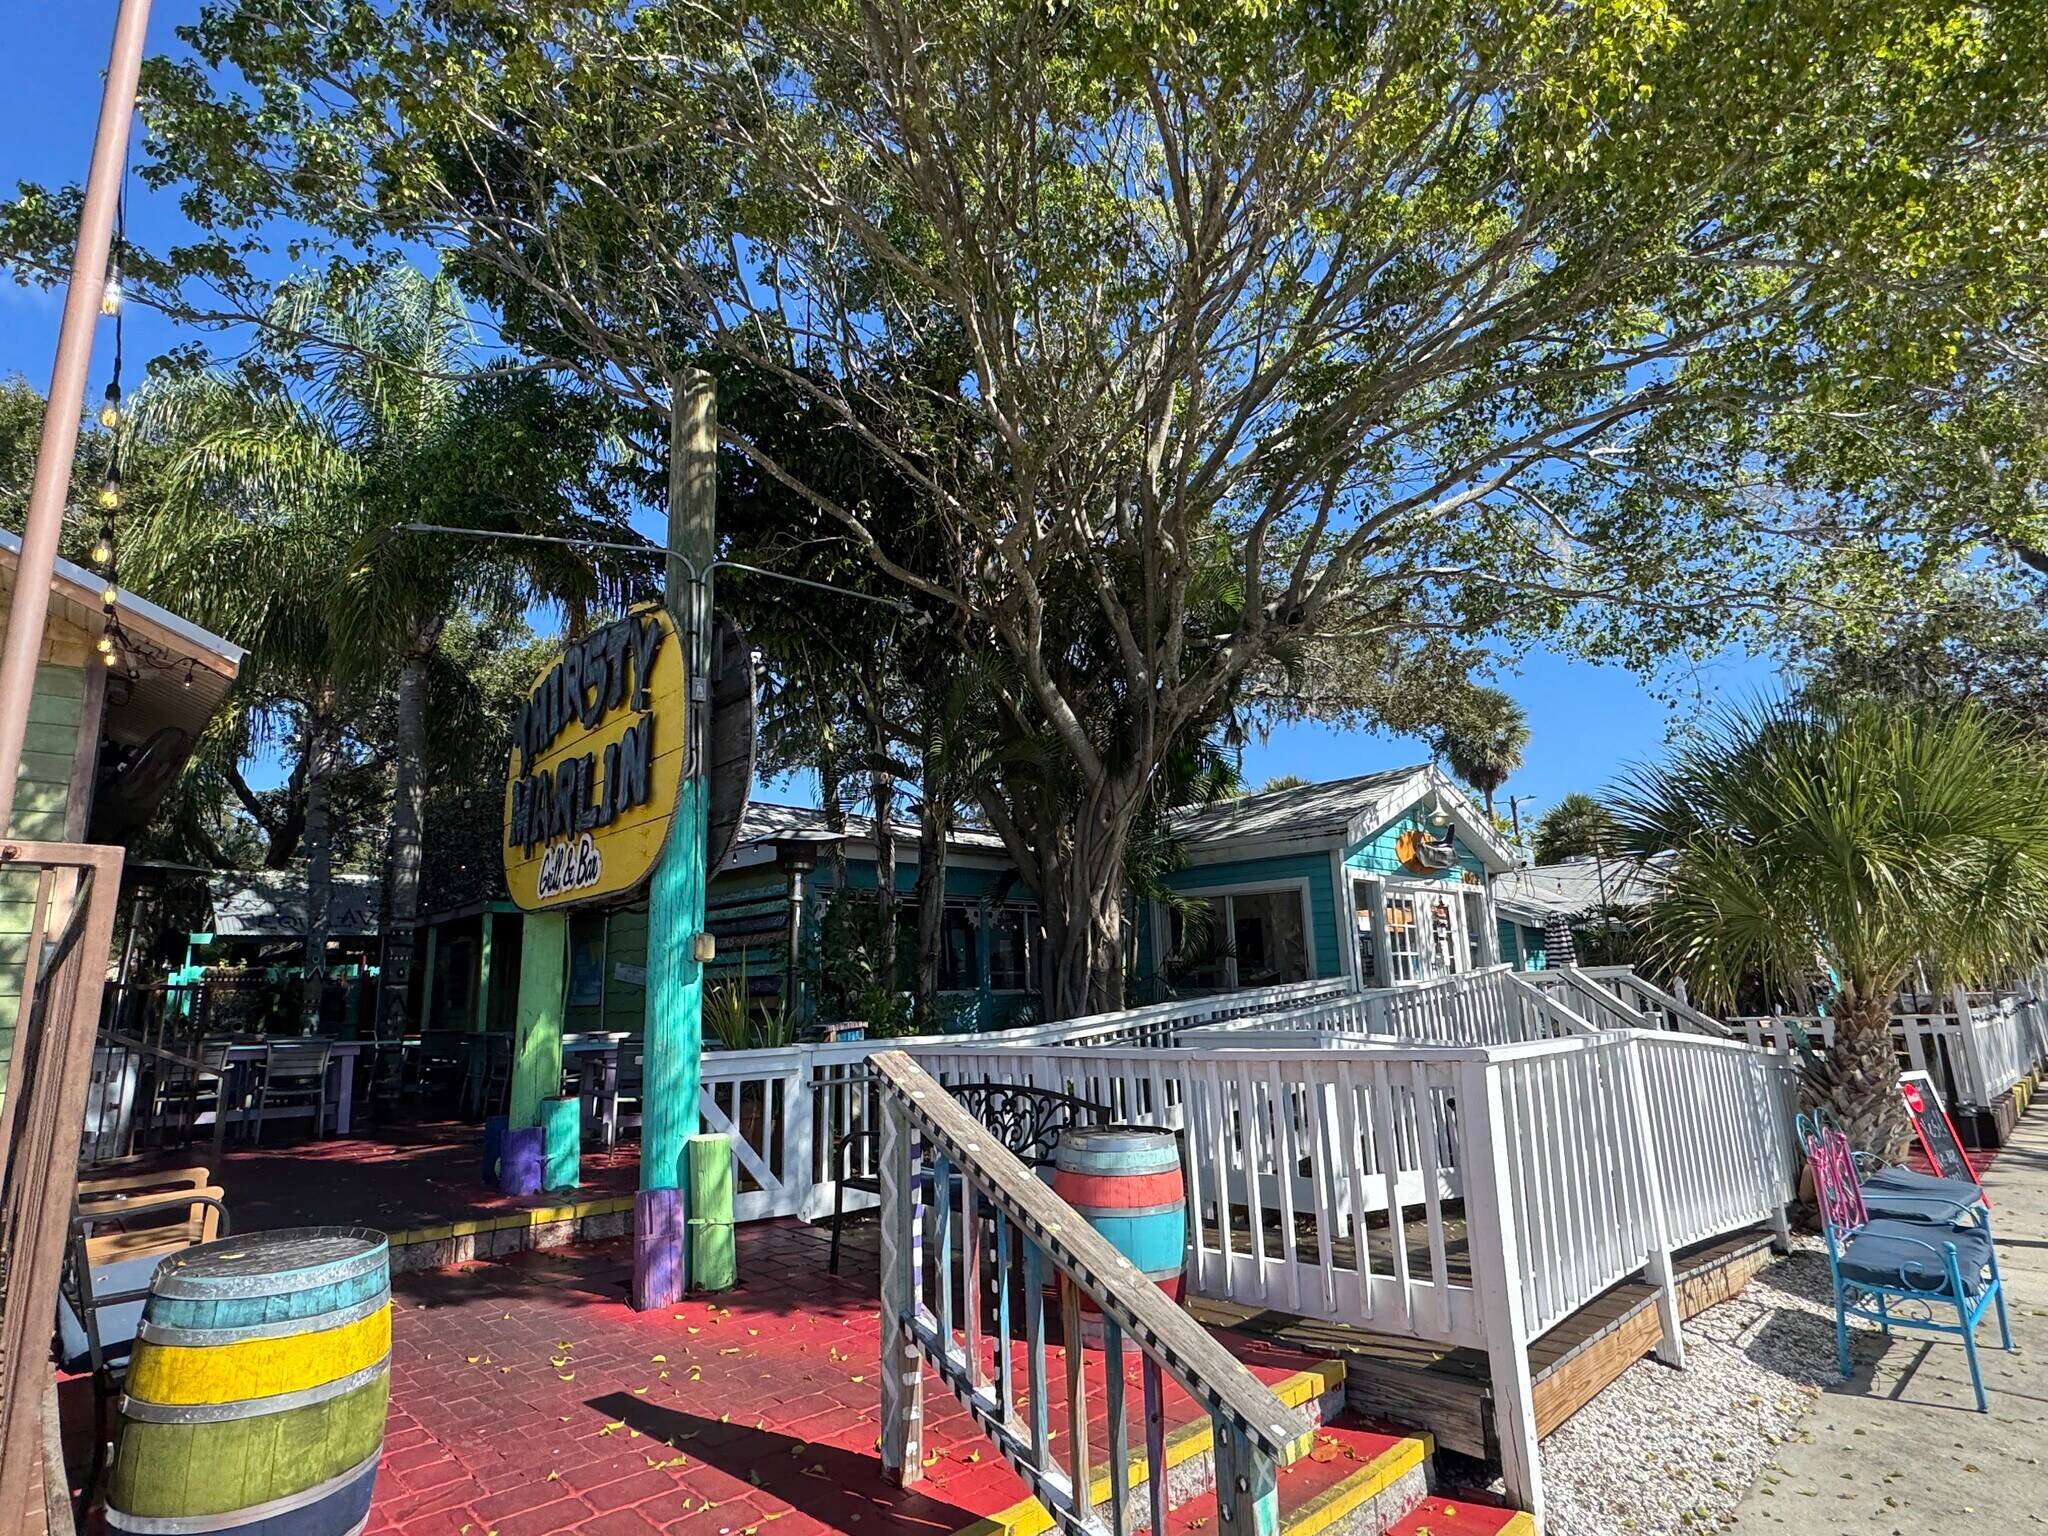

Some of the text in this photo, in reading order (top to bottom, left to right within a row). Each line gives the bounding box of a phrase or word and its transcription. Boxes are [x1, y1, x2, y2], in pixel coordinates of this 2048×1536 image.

[512, 616, 661, 780] THIRSTY
[509, 711, 653, 859] MARLIN
[539, 839, 598, 895] Grill & Bar
